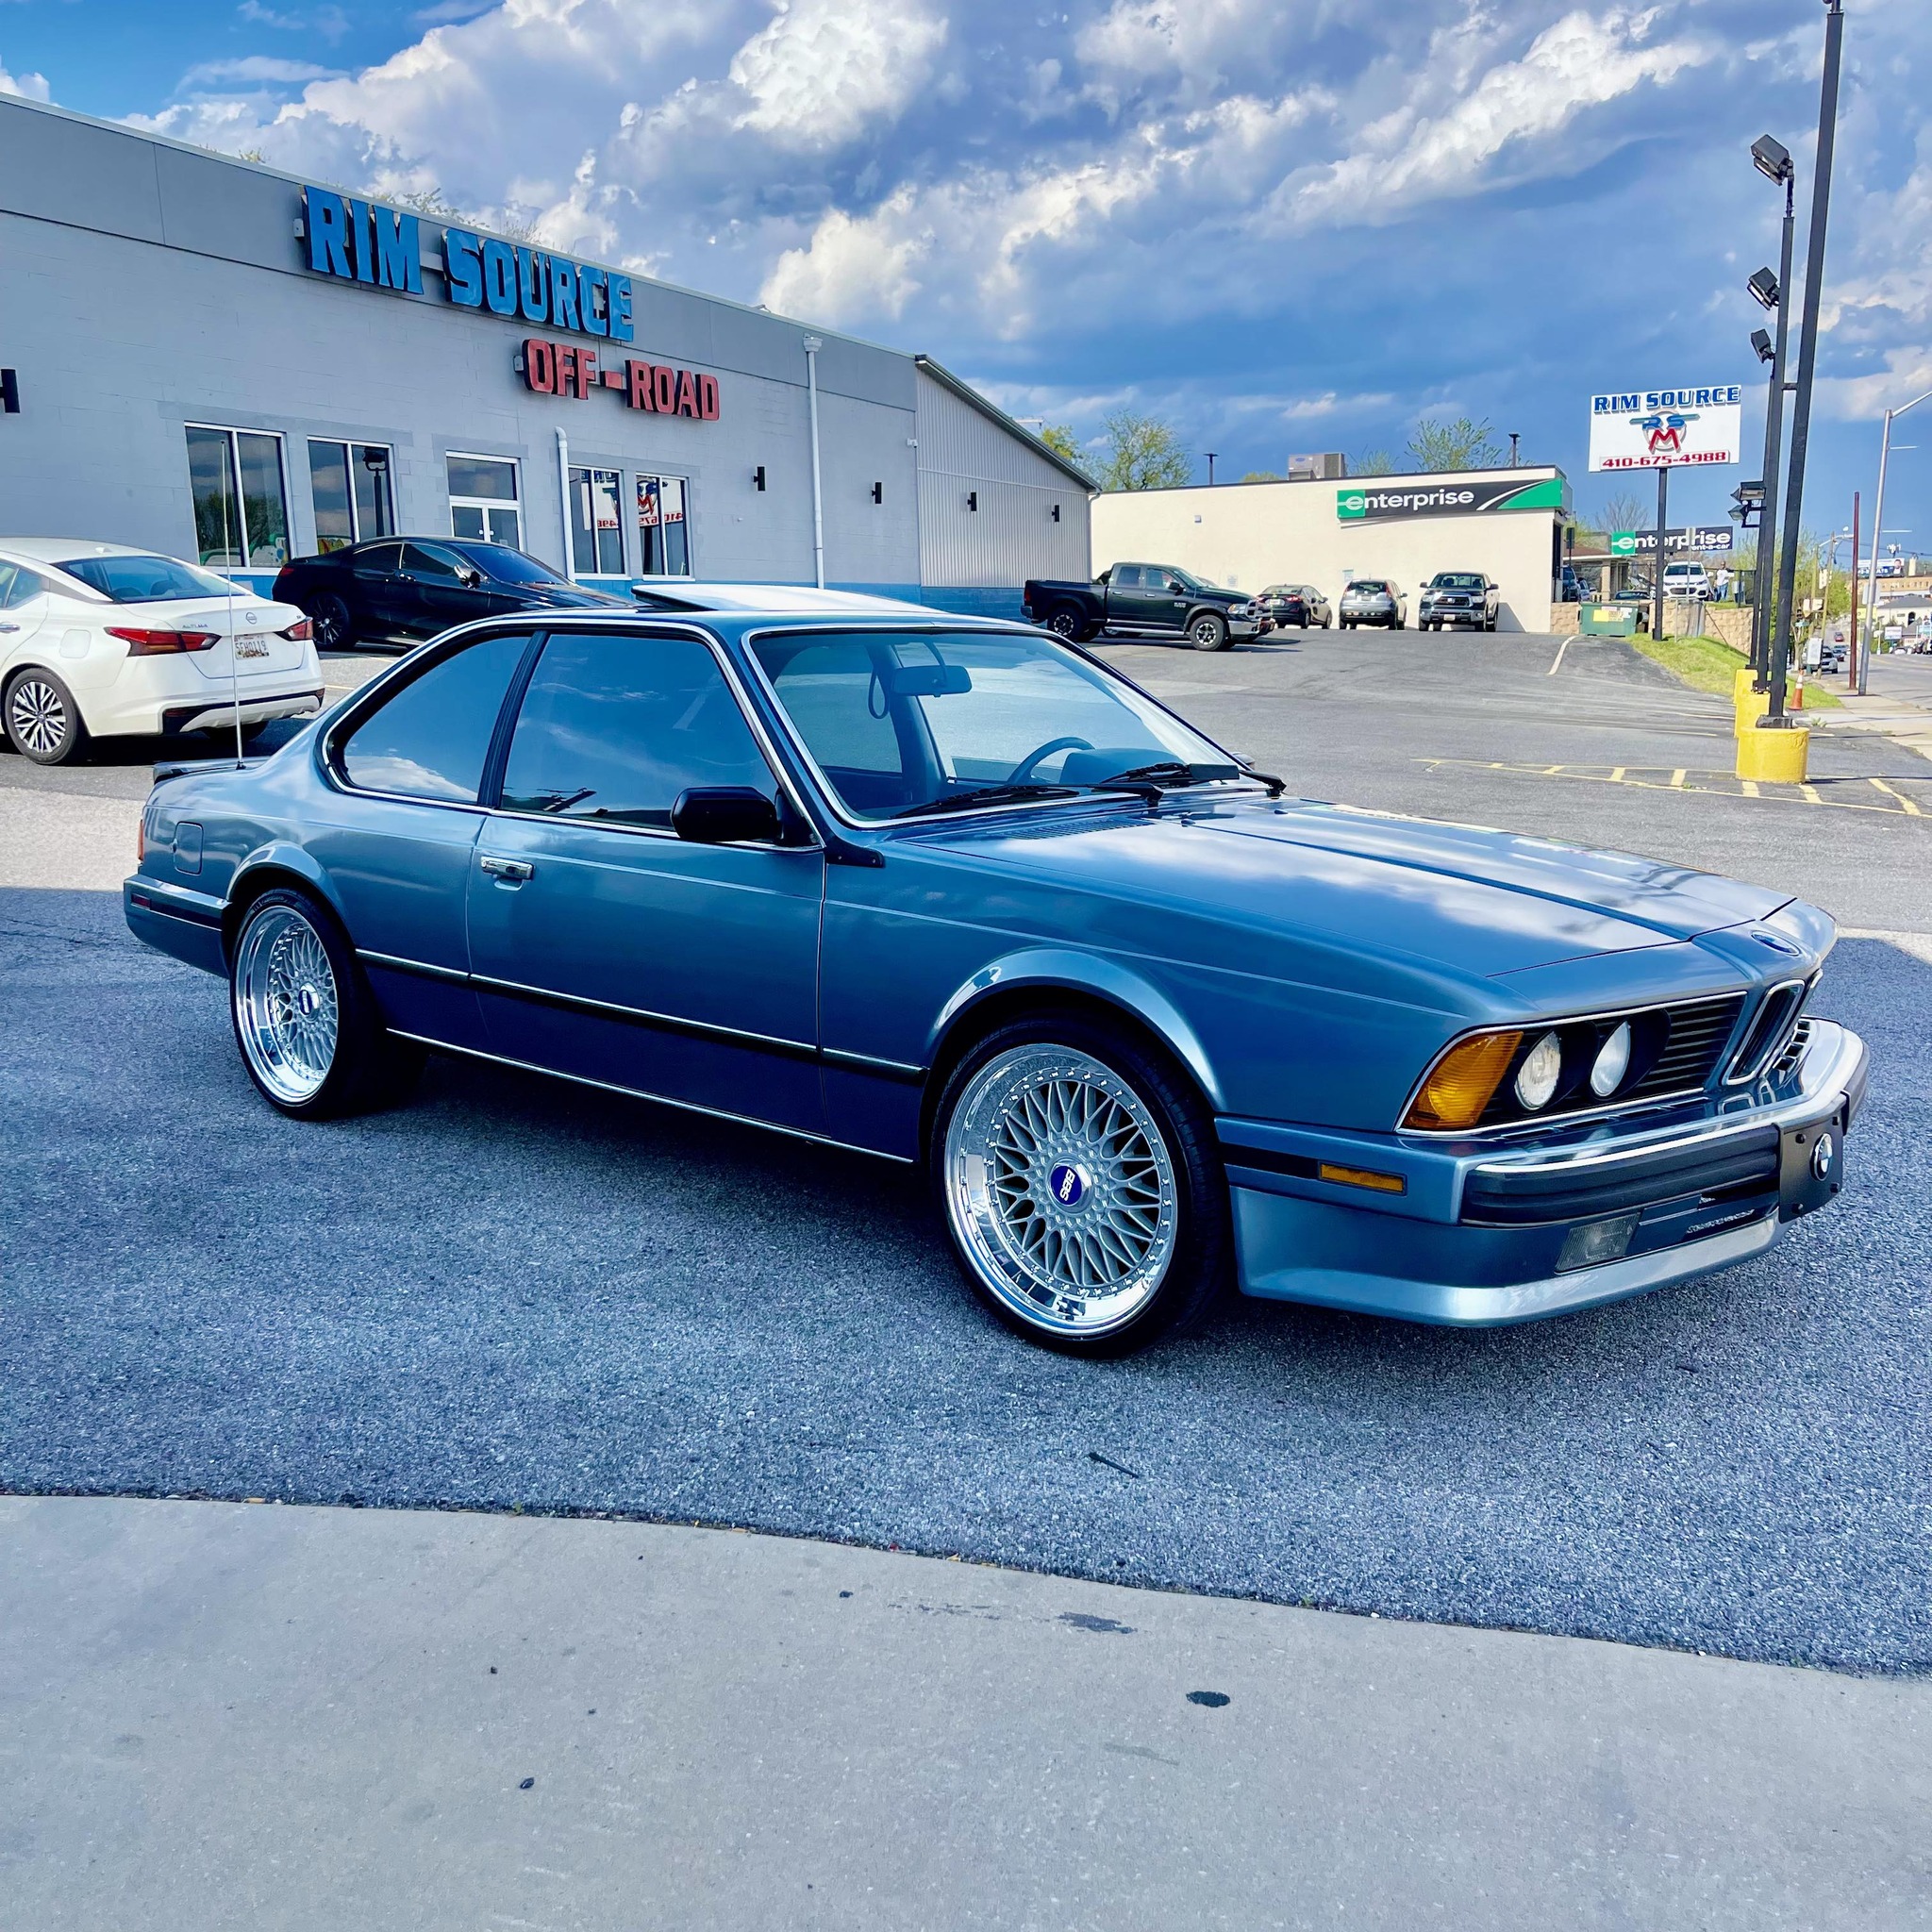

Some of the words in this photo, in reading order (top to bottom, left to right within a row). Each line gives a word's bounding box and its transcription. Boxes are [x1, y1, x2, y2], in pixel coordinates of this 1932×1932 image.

[303, 184, 425, 294] RIM
[442, 227, 634, 342] SOURCE
[1593, 394, 1640, 412] RIM
[1646, 387, 1740, 408] SOURCE
[1602, 452, 1726, 468] 410-675-4988
[1344, 488, 1474, 511] enterprise
[1059, 1169, 1075, 1201] BBS
